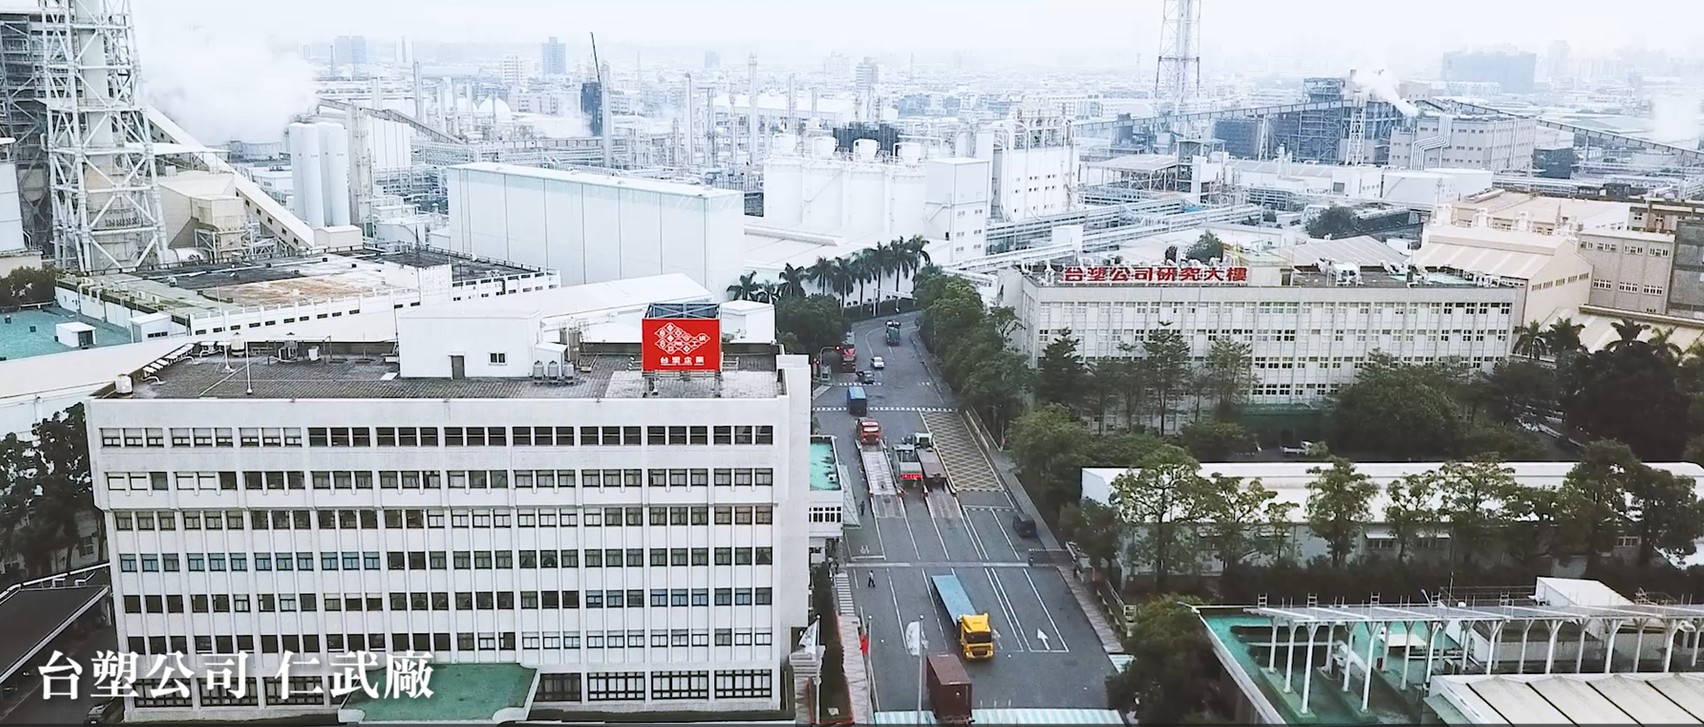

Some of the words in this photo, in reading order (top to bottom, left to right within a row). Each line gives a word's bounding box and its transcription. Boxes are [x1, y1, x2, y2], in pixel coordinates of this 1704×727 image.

[1064, 266, 1248, 282] 台塑公司研究大樓
